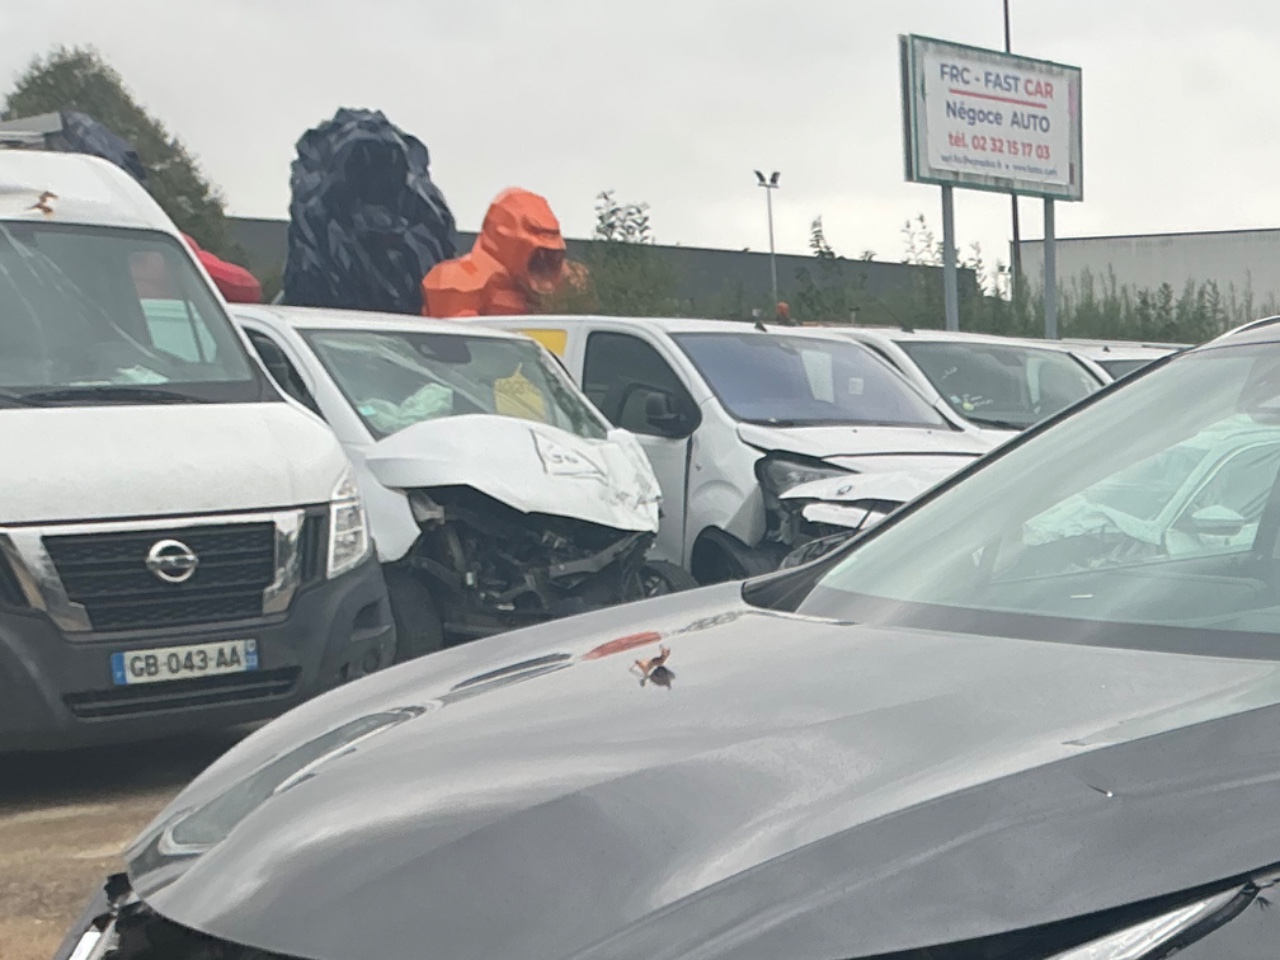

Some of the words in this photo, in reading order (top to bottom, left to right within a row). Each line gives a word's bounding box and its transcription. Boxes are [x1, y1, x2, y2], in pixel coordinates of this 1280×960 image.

[940, 63, 970, 85] FRC
[984, 71, 1020, 94] FAST
[1024, 79, 1053, 99] CAR
[946, 100, 1002, 126] Négoce
[1010, 111, 1050, 133] AUTO
[971, 135, 987, 151] 02
[990, 139, 1004, 154] 32
[1007, 141, 1019, 156] 15
[1021, 144, 1033, 158] 17
[1035, 145, 1051, 160] 03
